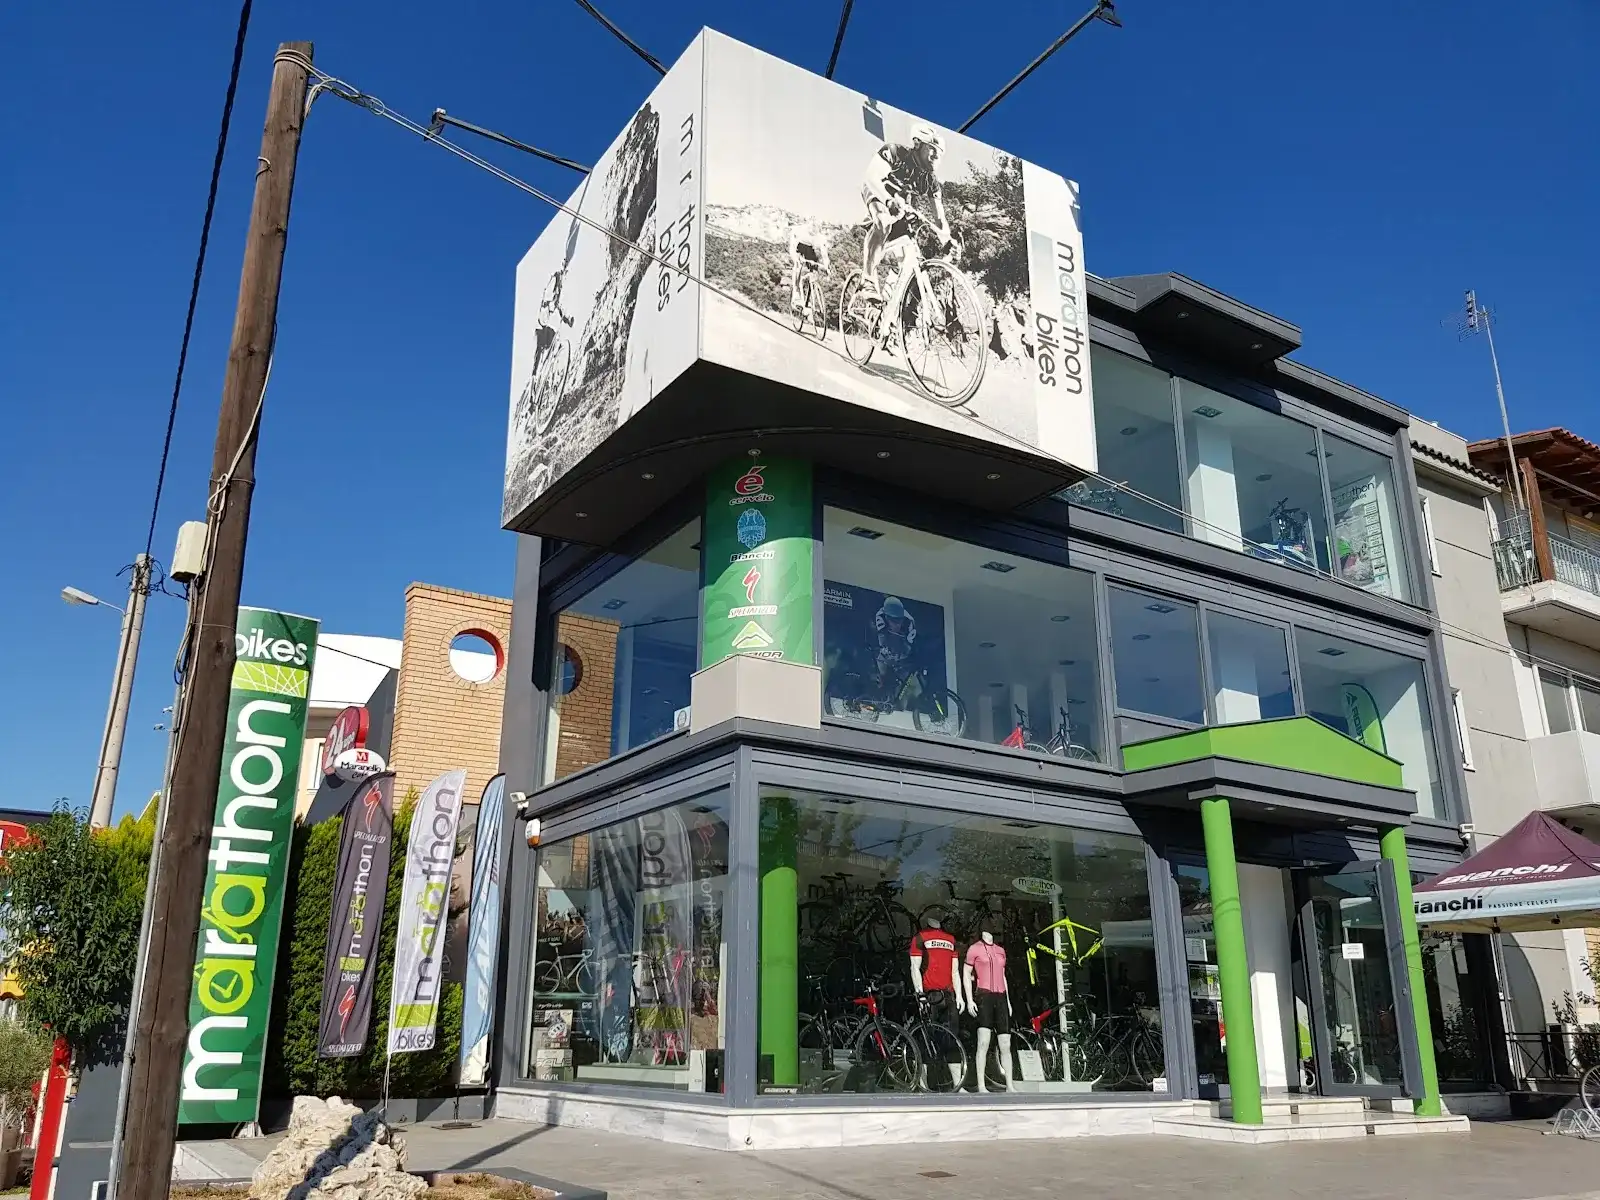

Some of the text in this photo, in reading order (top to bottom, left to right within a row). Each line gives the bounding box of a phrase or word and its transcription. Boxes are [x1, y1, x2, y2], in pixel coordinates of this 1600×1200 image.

[677, 113, 695, 293] mrthon
[1057, 241, 1085, 395] marathon
[1036, 312, 1060, 387] bikes
[731, 551, 774, 561] Bianchi
[341, 762, 381, 772] Maranello
[1436, 863, 1572, 886] Bianchi
[183, 700, 291, 1101] marathon
[349, 844, 374, 958] marathon
[1414, 895, 1483, 914] ianchi
[1526, 899, 1558, 907] CELESTE
[396, 1029, 434, 1050] bikes
